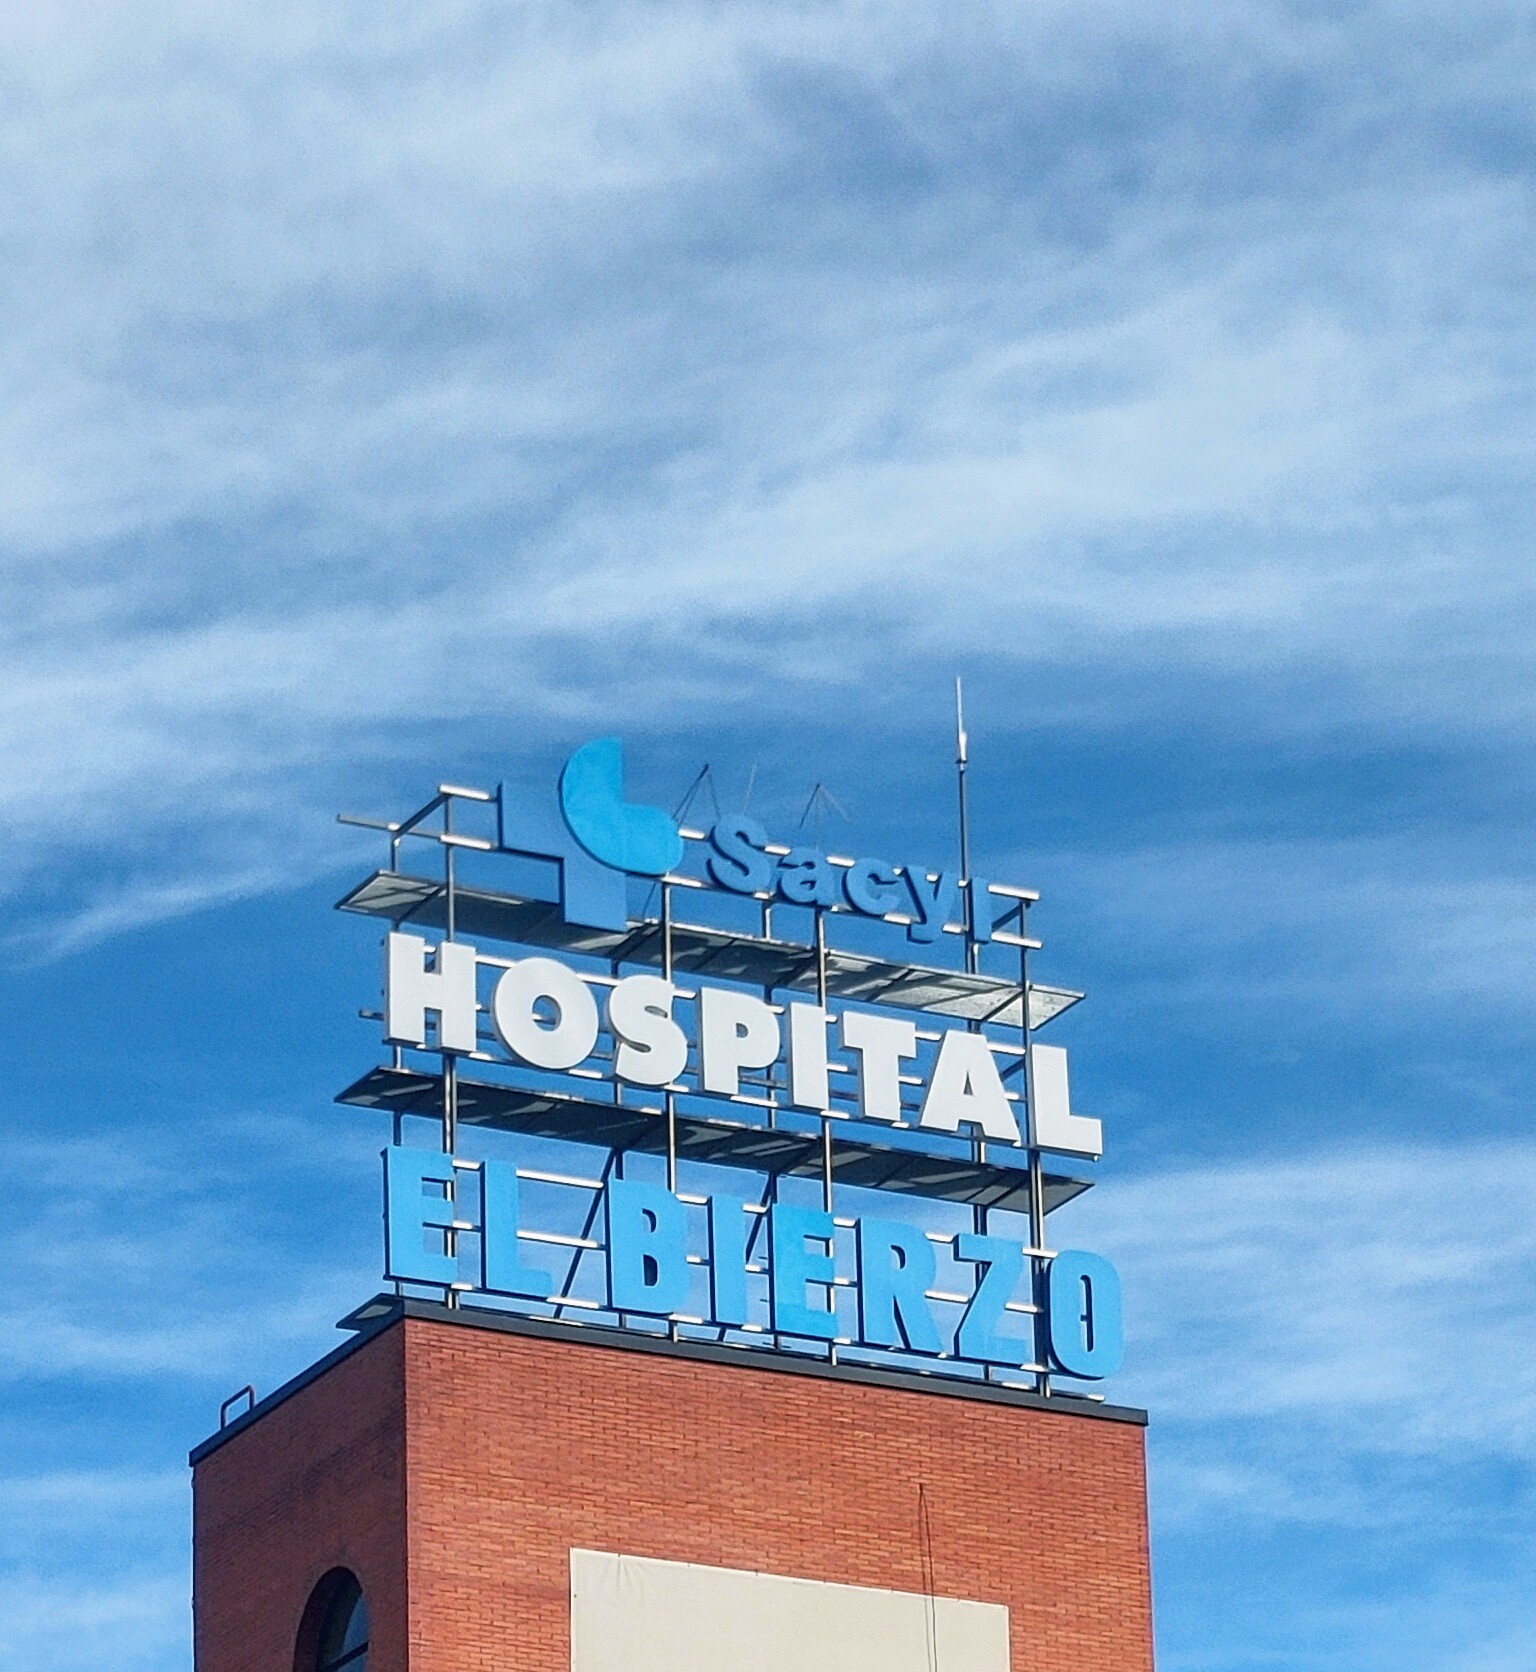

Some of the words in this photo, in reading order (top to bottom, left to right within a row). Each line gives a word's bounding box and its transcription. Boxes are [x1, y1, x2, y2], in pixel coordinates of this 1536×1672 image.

[707, 813, 993, 943] Sacyl
[383, 931, 1103, 1159] HOSPITAL
[382, 1145, 553, 1299] EL
[606, 1178, 1127, 1380] BIERZO
